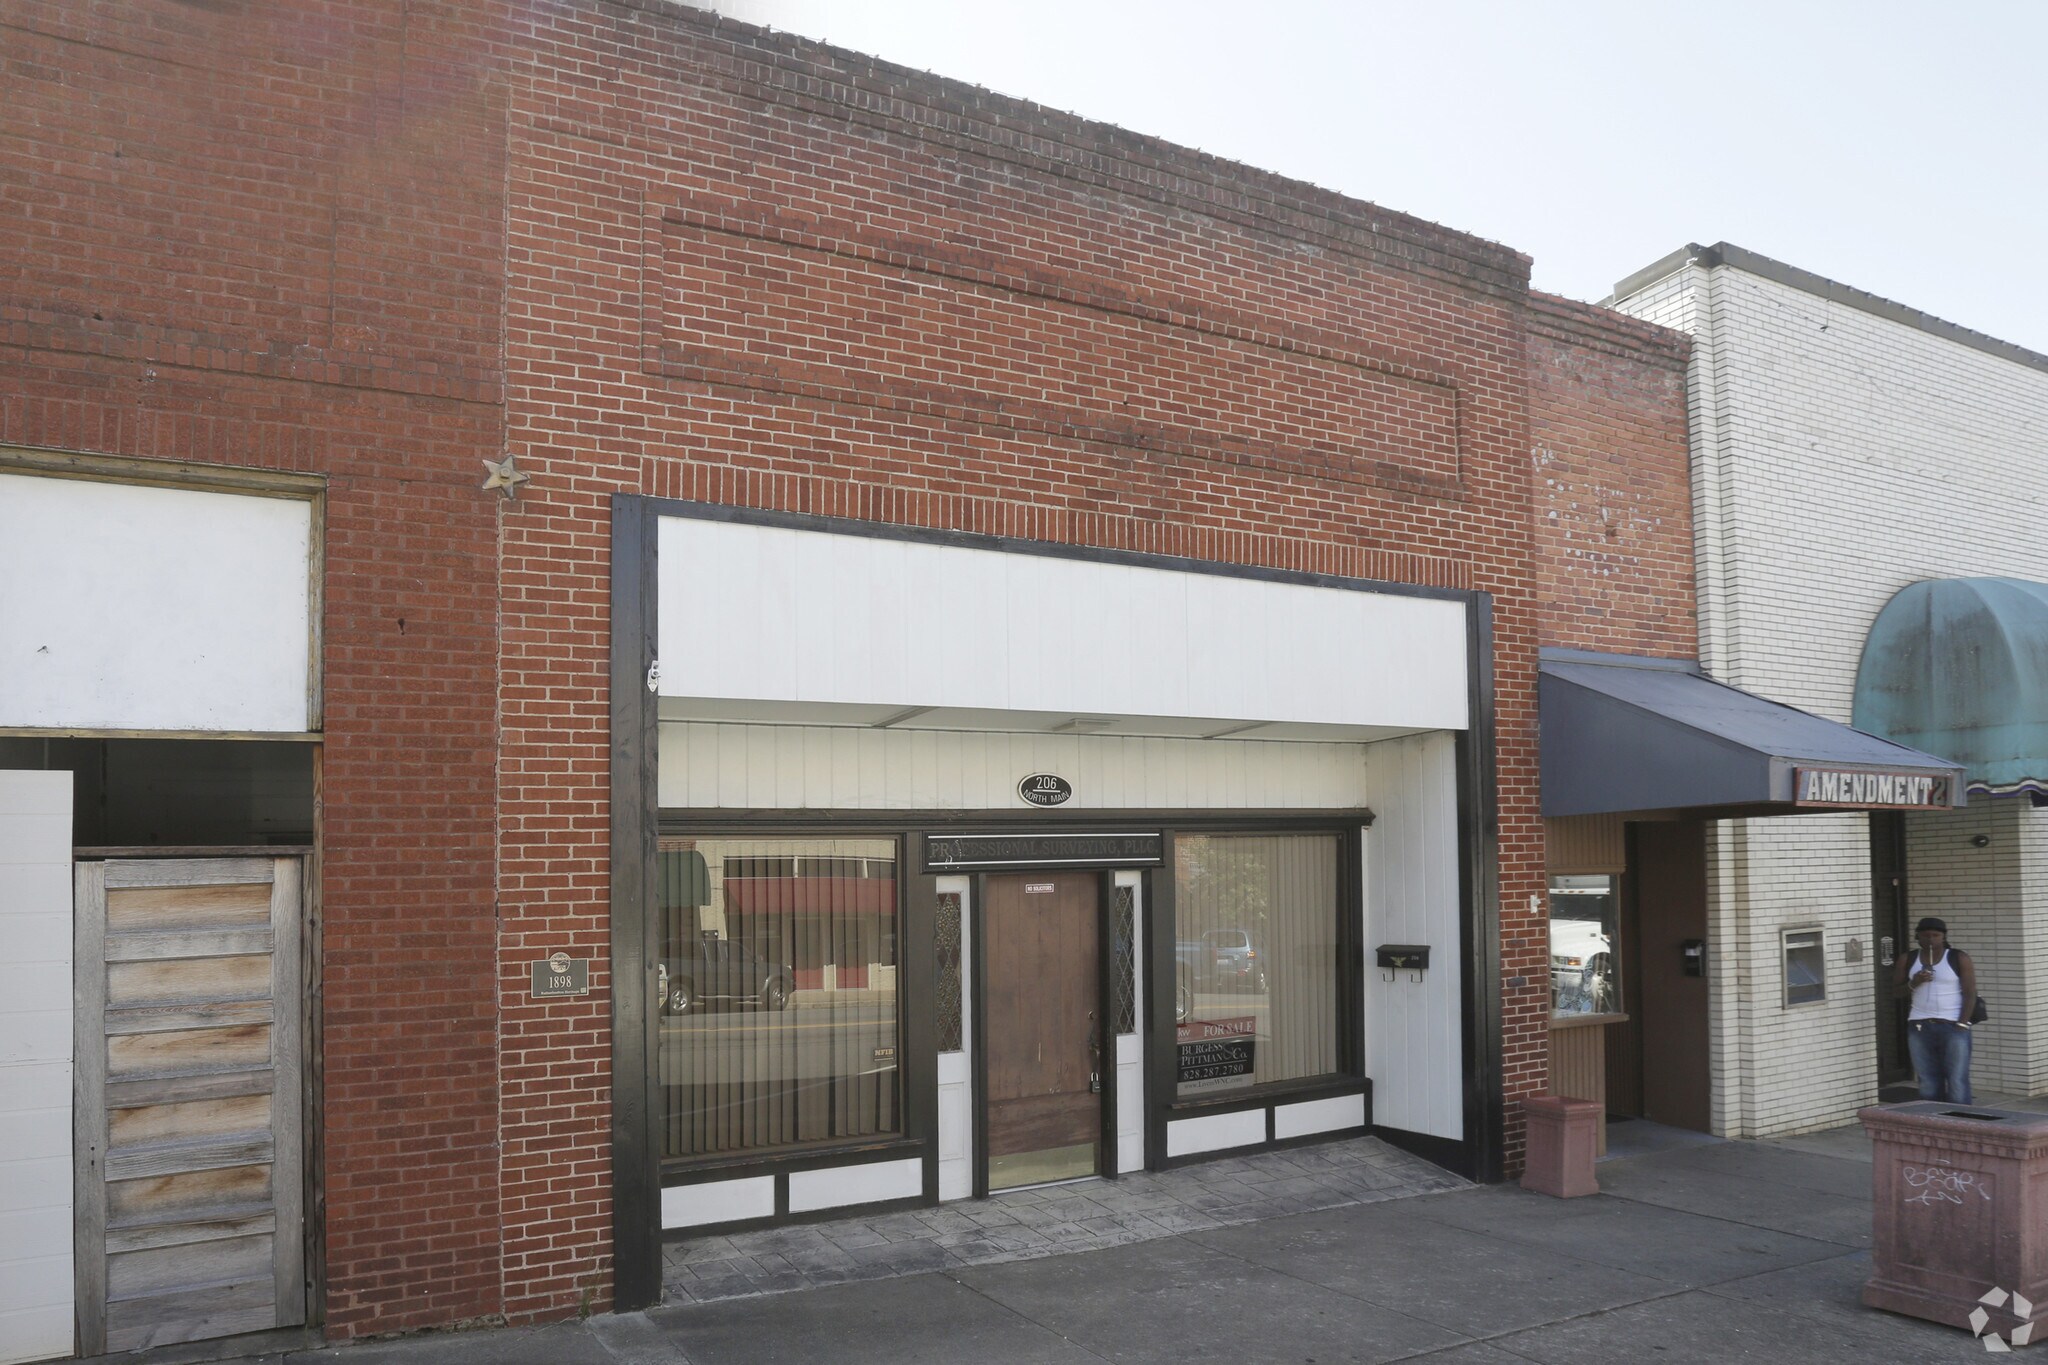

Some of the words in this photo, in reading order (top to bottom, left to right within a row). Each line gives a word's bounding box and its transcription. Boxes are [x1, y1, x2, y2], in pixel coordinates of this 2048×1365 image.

[1036, 776, 1057, 789] 206
[1806, 770, 1933, 806] AMENDMENT
[1933, 778, 1946, 807] 2
[1023, 789, 1047, 802] NORTH
[1050, 790, 1070, 803] MAIN
[929, 841, 1037, 858] PROFESSIONAL
[549, 975, 572, 989] 1898
[1204, 1024, 1224, 1037] FOR
[1226, 1021, 1253, 1034] SALE
[1182, 1043, 1222, 1055] BURGESS
[1181, 1053, 1222, 1066] PITTMAN
[1183, 1064, 1244, 1080] 828.287.2780
